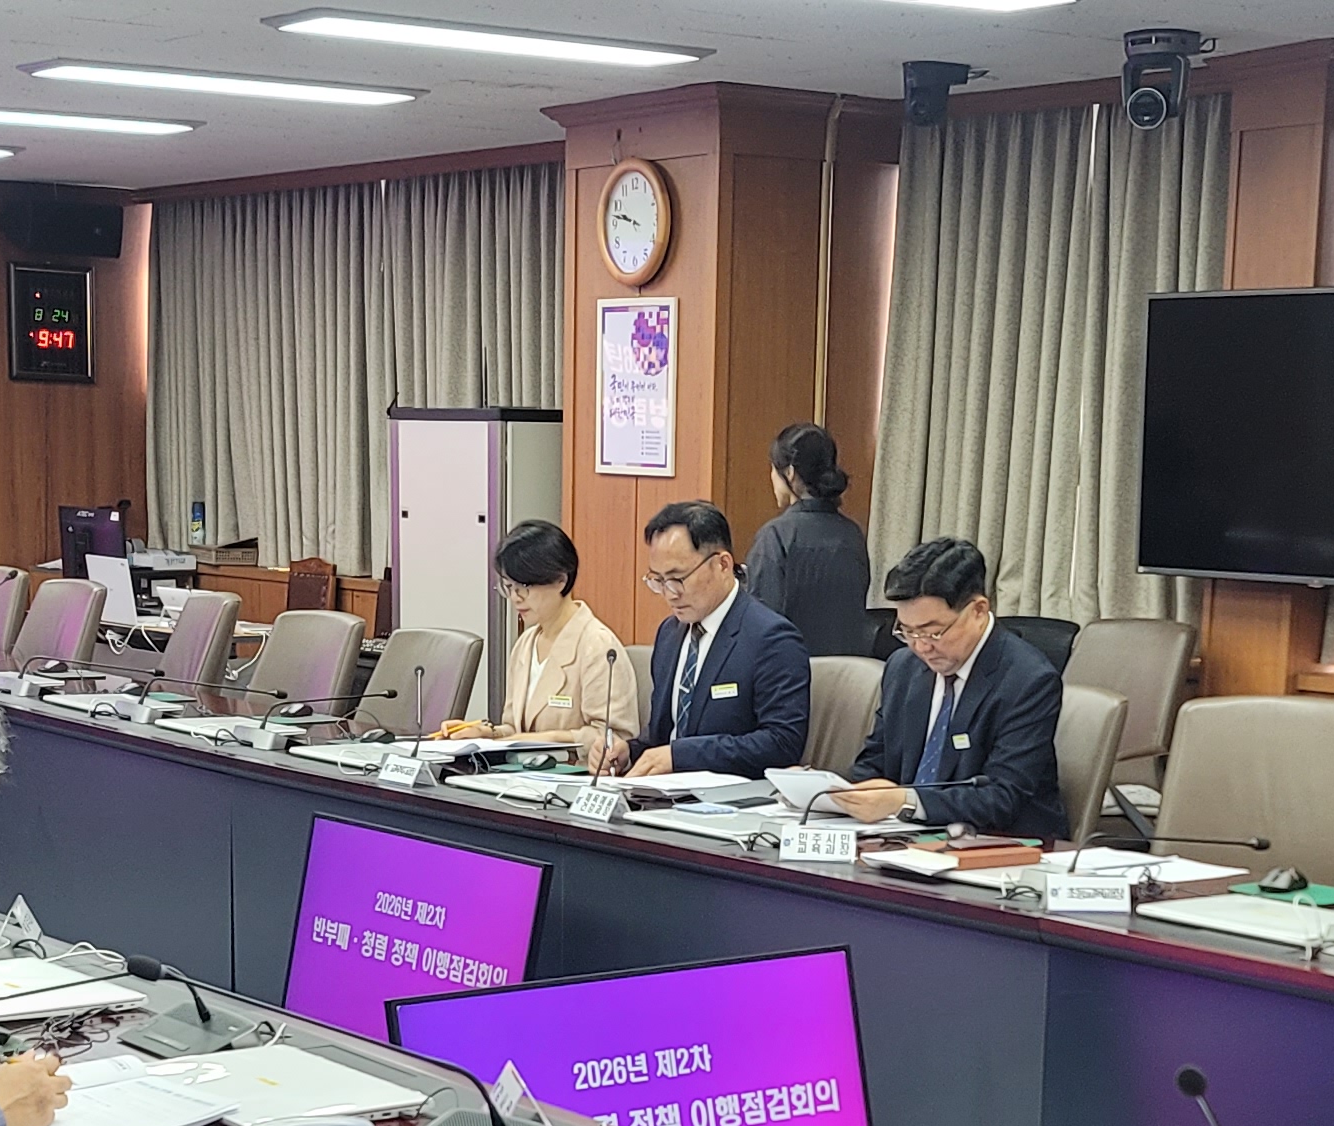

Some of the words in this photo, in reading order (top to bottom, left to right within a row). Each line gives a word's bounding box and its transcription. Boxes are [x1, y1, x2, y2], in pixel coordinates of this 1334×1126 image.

[34, 308, 43, 321] 8
[52, 309, 69, 322] 24
[37, 330, 75, 349] 9:47
[798, 832, 850, 845] 민주시민
[797, 843, 849, 856] 교육과장
[374, 891, 414, 921] 2026년
[415, 900, 446, 930] 제2차
[312, 916, 351, 950] 반부패
[361, 930, 389, 962] 청렴
[391, 939, 419, 971] 정책
[572, 1052, 649, 1090] 2026년
[654, 1044, 712, 1078] 제2차
